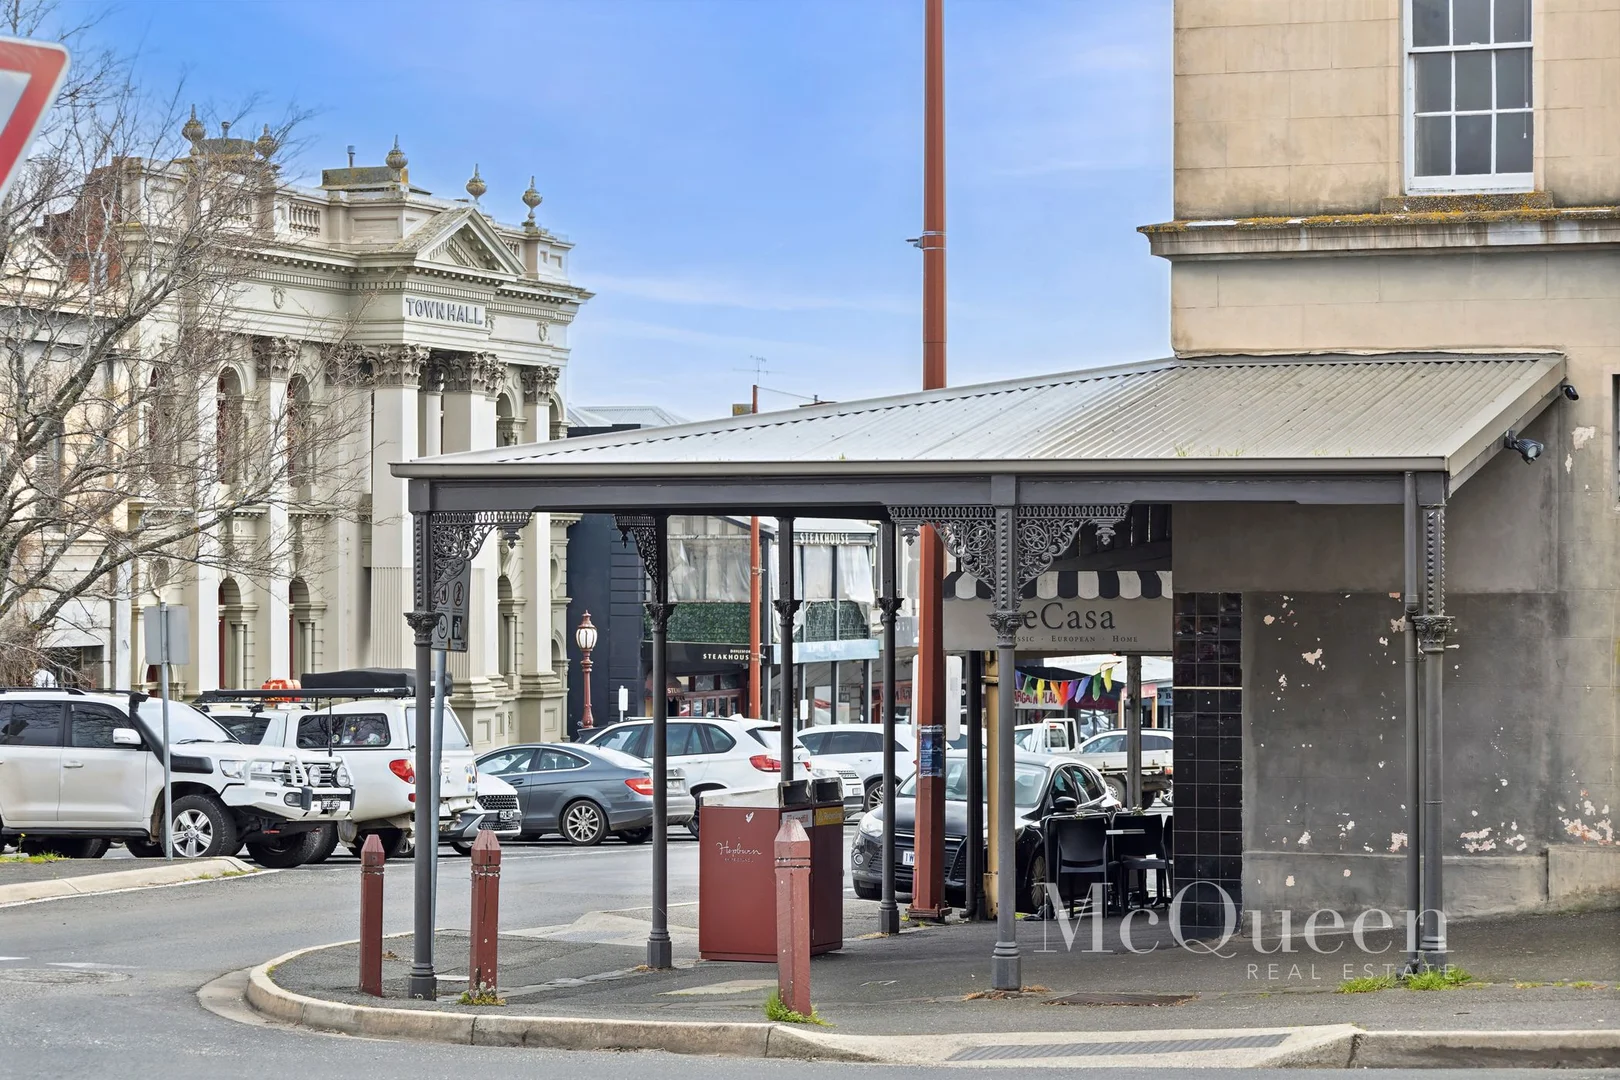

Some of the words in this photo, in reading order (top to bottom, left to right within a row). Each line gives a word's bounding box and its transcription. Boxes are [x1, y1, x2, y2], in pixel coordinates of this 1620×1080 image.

[799, 532, 849, 545] STEAKHOUSE
[1024, 602, 1115, 630] eCasa
[703, 653, 749, 661] STEAKHOUS
[716, 841, 762, 857] Hepburn
